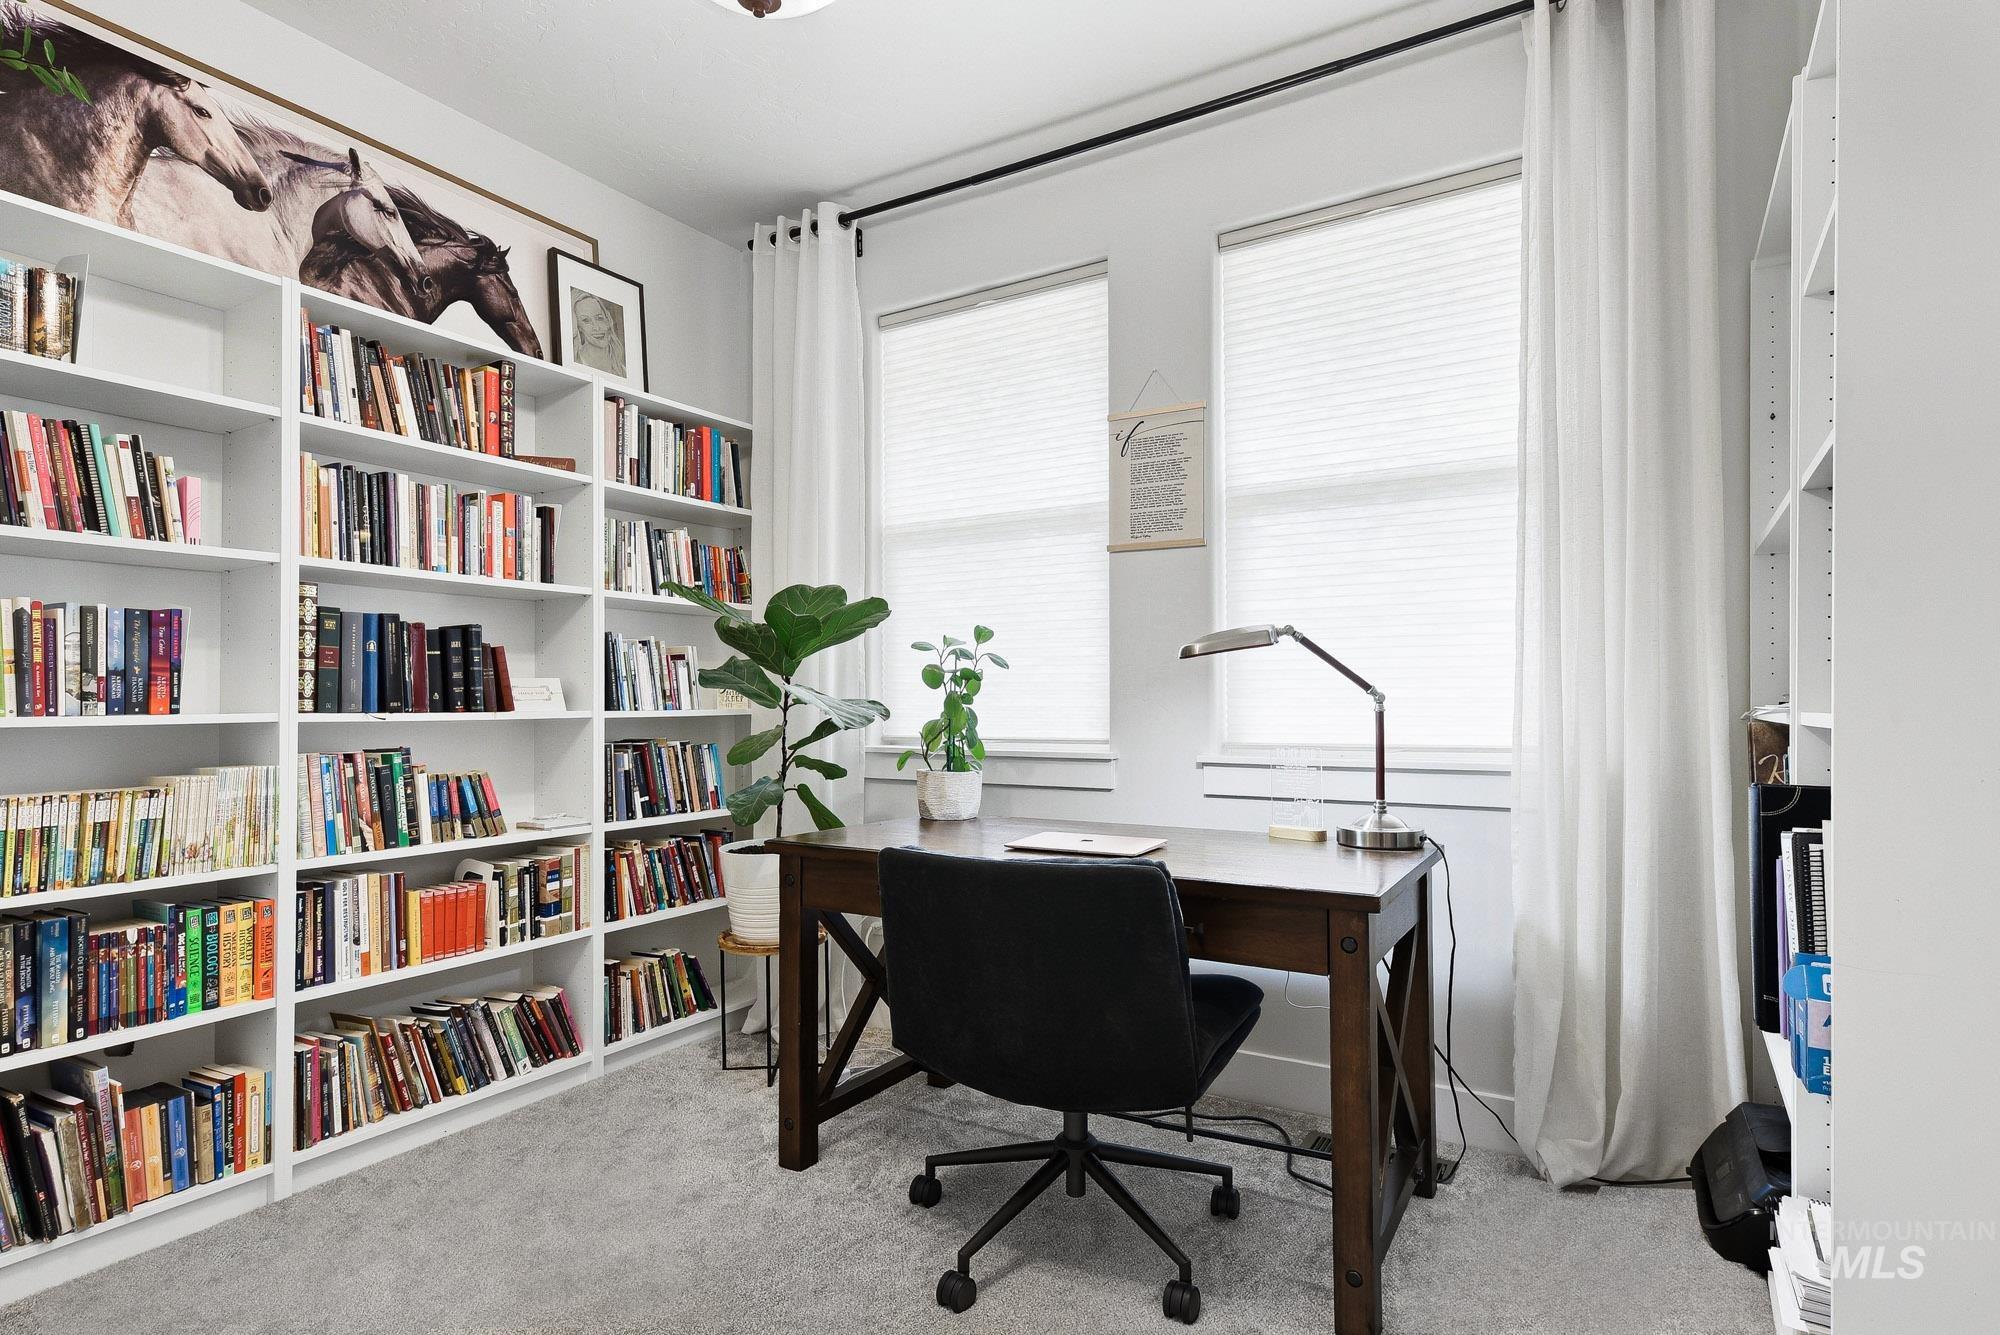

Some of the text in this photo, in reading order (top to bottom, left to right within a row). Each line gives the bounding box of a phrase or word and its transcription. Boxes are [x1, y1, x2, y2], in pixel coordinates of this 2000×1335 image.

[32, 610, 42, 620] THE
[32, 621, 42, 646] ANXIETY
[178, 932, 186, 957] DOG MAN
[190, 938, 200, 978] SCIENCE
[206, 934, 218, 976] BIOLOGY
[223, 932, 232, 968] HISTORY
[264, 925, 272, 963] ENGLISH
[100, 1088, 112, 1141] Picture Atlas
[225, 1122, 234, 1158] Mockingbird
